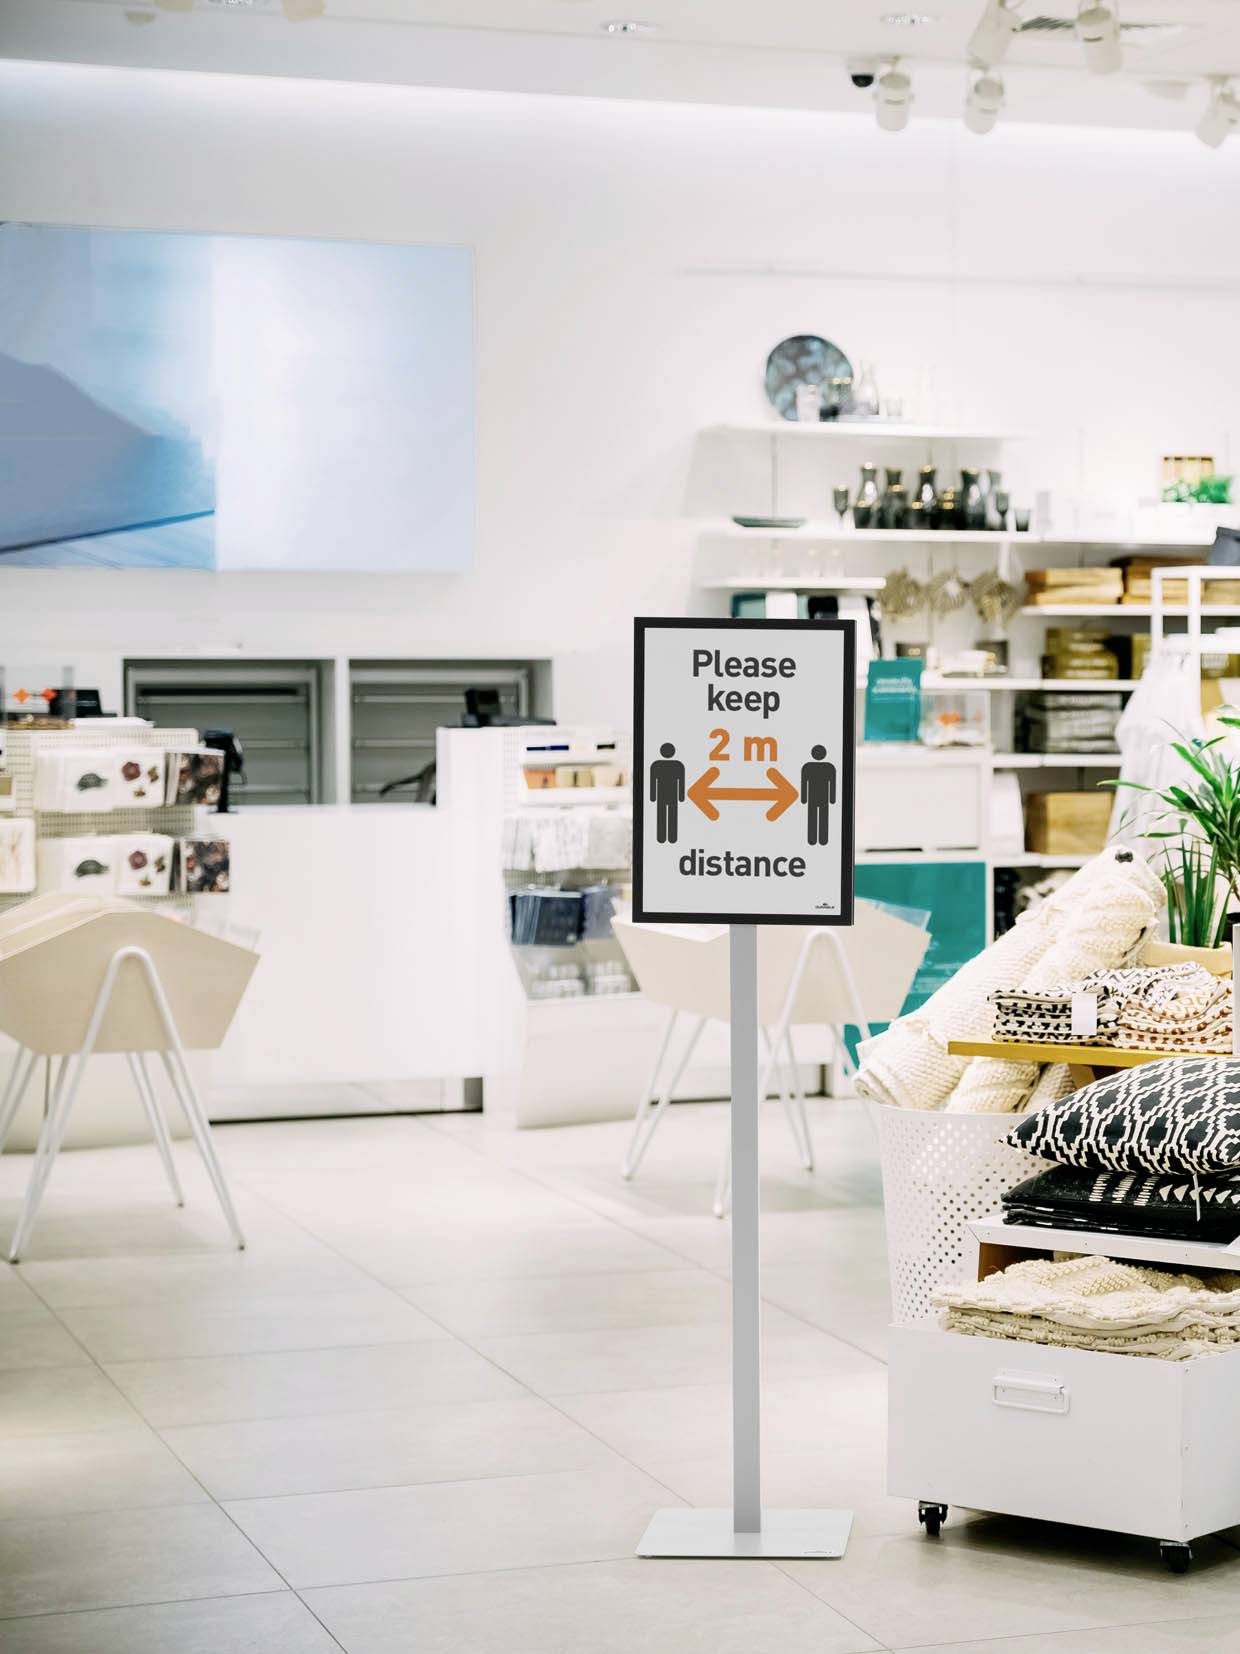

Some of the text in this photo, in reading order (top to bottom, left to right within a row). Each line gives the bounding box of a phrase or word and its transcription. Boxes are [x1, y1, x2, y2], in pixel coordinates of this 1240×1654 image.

[692, 649, 797, 679] Please
[707, 684, 781, 719] keep
[708, 728, 778, 762] 2 m
[678, 849, 807, 878] distance
